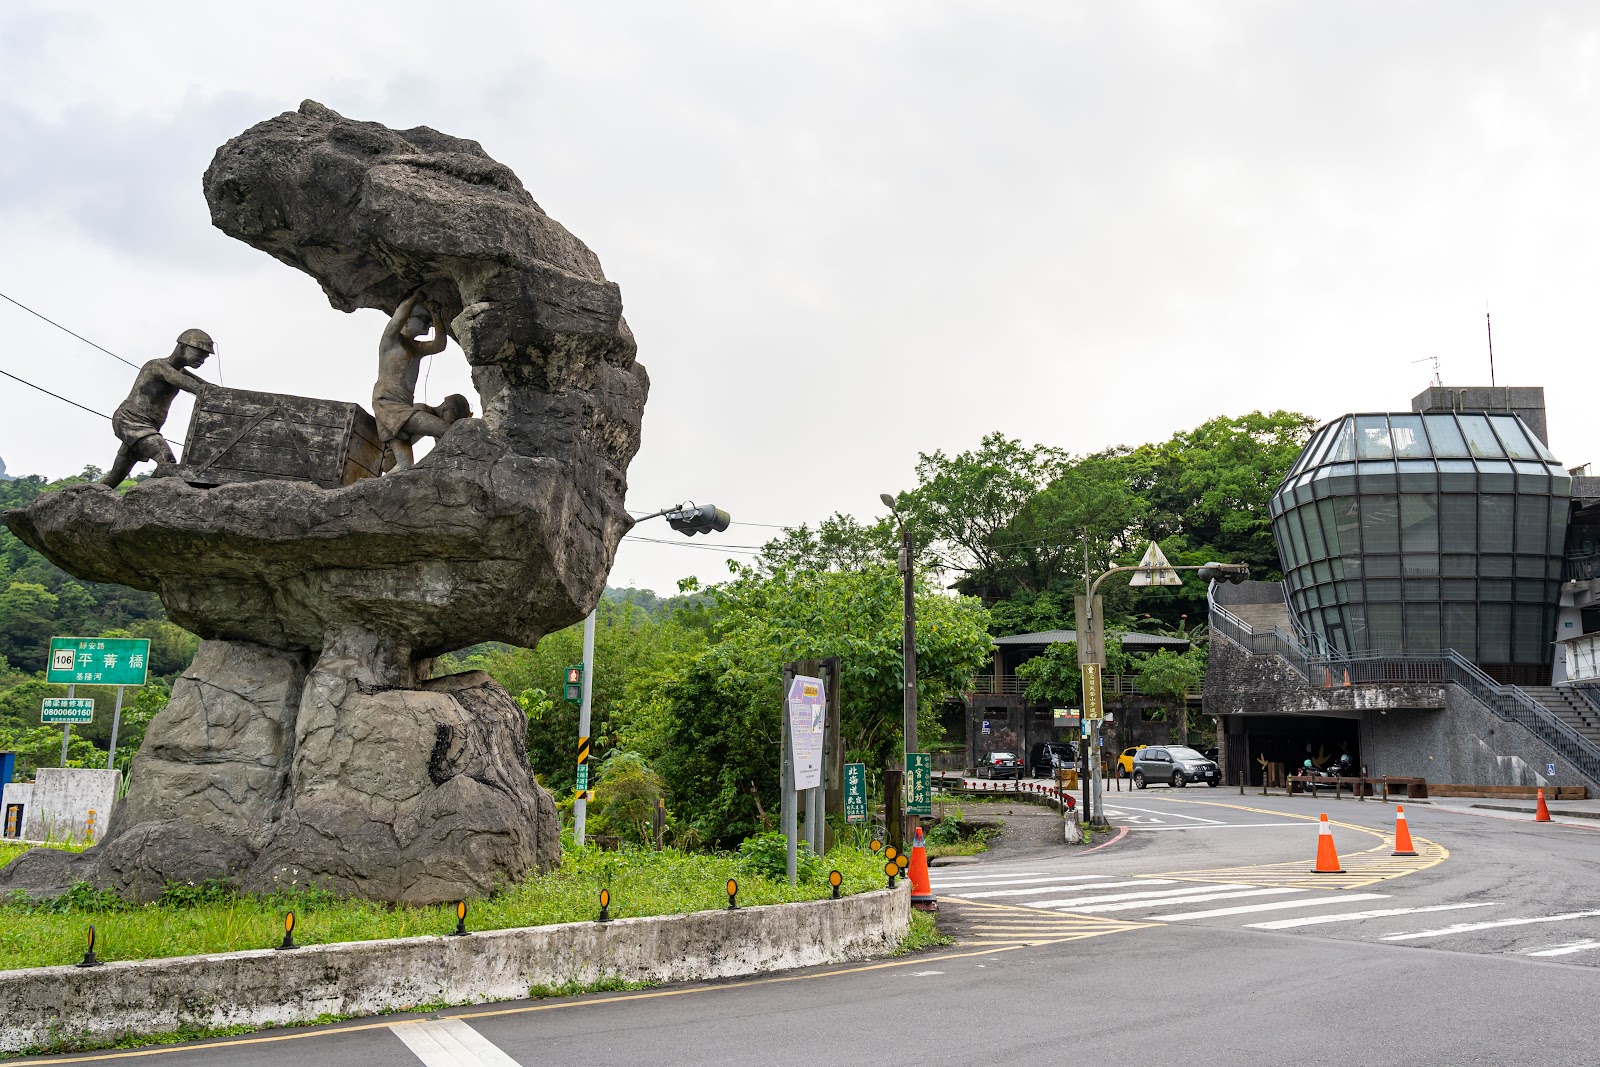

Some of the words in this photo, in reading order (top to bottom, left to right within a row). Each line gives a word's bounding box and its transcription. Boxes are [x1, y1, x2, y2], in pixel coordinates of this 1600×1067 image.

[56, 656, 72, 665] 106
[77, 653, 144, 669] 平菁橋
[76, 672, 103, 681] 基隆河
[43, 708, 91, 716] 0800060160
[982, 720, 990, 728] P
[848, 766, 860, 796] 北海道
[914, 755, 925, 804] 皇宮茶坊
